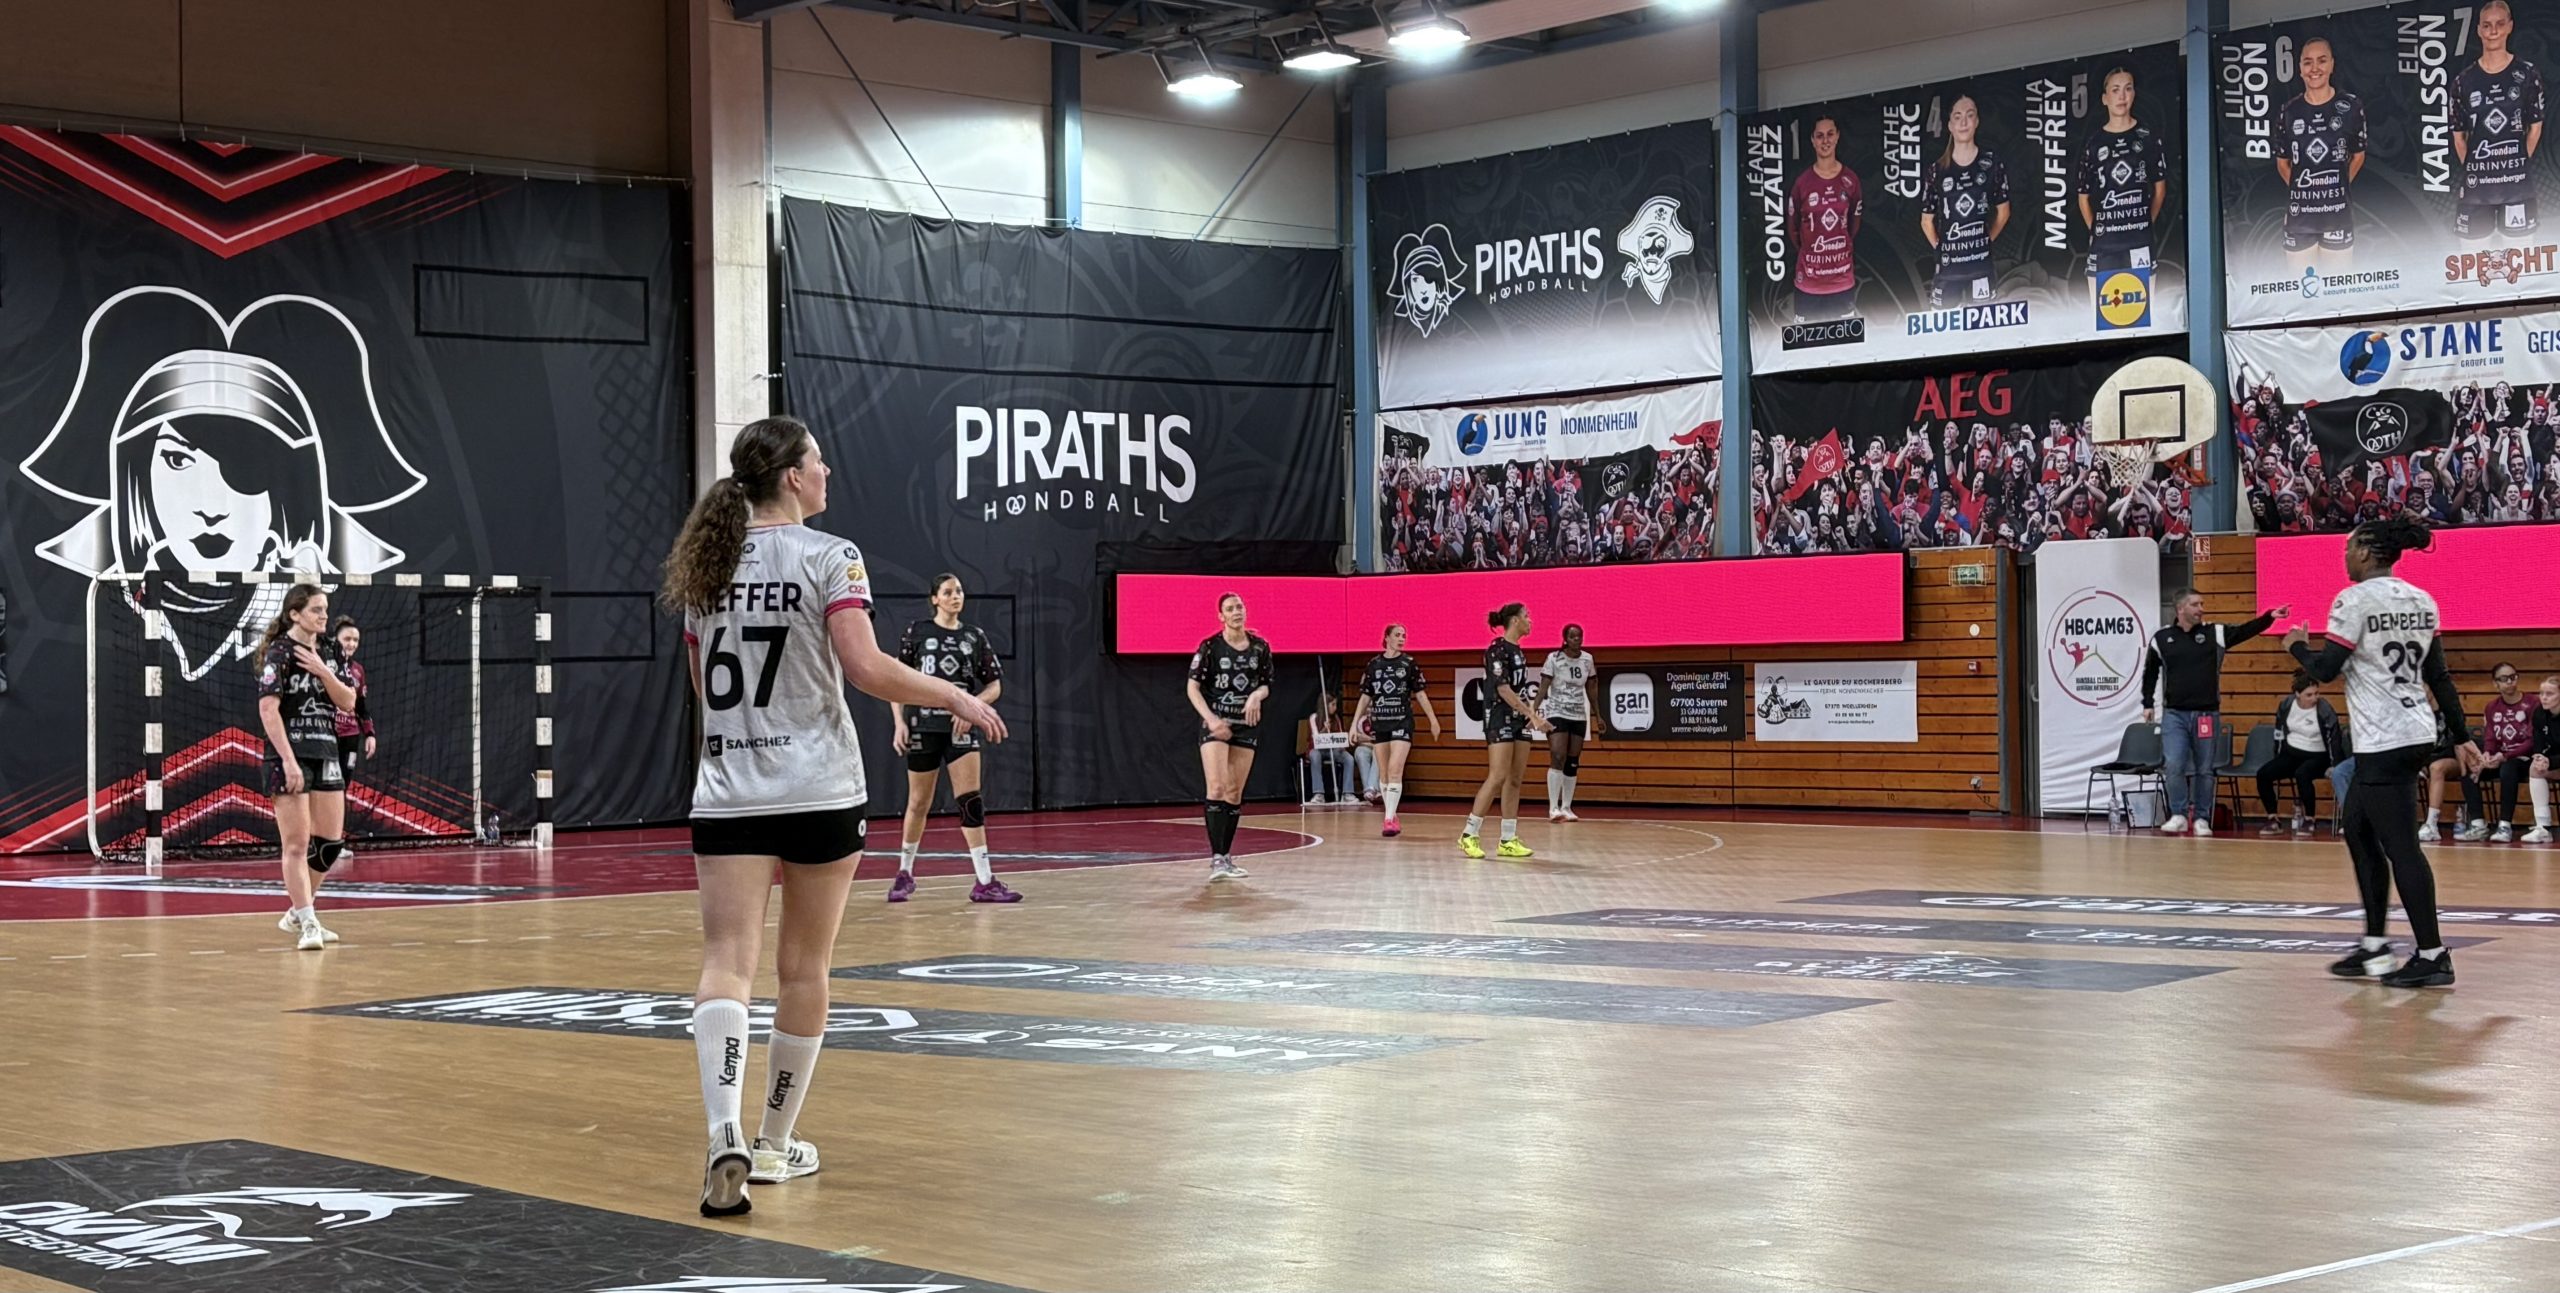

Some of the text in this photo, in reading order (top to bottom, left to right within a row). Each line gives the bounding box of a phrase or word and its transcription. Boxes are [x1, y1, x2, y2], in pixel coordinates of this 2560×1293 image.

[2398, 17, 2418, 74] ELIN
[2453, 7, 2473, 56] 7
[2275, 36, 2294, 83] 6
[2072, 73, 2088, 119] 5
[2223, 45, 2244, 118] LILOU
[2243, 42, 2270, 159] BEGON
[1926, 96, 1941, 138] 4
[2026, 79, 2043, 145] JULIA
[2419, 15, 2450, 192] KARLSSON
[1790, 119, 1800, 160] 1
[1883, 105, 1899, 196] AGATHE
[1900, 103, 1921, 198] CLERC
[2472, 140, 2519, 159] Brondani
[1748, 125, 1763, 197] LÉANE
[2044, 78, 2067, 250] MAUFFREY
[2295, 168, 2340, 188] Brondani
[2466, 157, 2526, 171] EURINVEST
[2479, 173, 2526, 185] wienerberger
[1762, 124, 1785, 281] GONZALEZ
[2096, 206, 2148, 221] EURINVEST
[1476, 227, 1604, 295] PIRATHS
[2251, 269, 2399, 295] PIERRES TERRITOIRES
[2400, 319, 2560, 361] STANE GEIS
[1914, 368, 2012, 422] AEG
[1493, 410, 1638, 440] JUNG MOMMENHEIM
[956, 405, 1197, 504] PIRATHS
[984, 490, 1170, 523] HANDBALL
[697, 582, 802, 619] EFFER
[2065, 617, 2134, 636] HBCAM63
[2367, 612, 2434, 633] DEMBELE
[705, 625, 789, 712] 67
[921, 654, 936, 675] 18
[1569, 666, 1583, 679] 18
[1666, 672, 1710, 683] Dominique
[1615, 693, 1649, 714] gan
[1670, 698, 1728, 707] 67700 Saverne
[726, 735, 791, 750] SANCHEZ
[1921, 897, 2341, 916] Grand
[1072, 971, 1336, 990] EQIOM
[1024, 1023, 1400, 1048] CONCESSIONNAIRE
[1024, 1038, 1361, 1061] SANY
[719, 1036, 743, 1087] Kempa
[768, 1070, 794, 1112] Kempa
